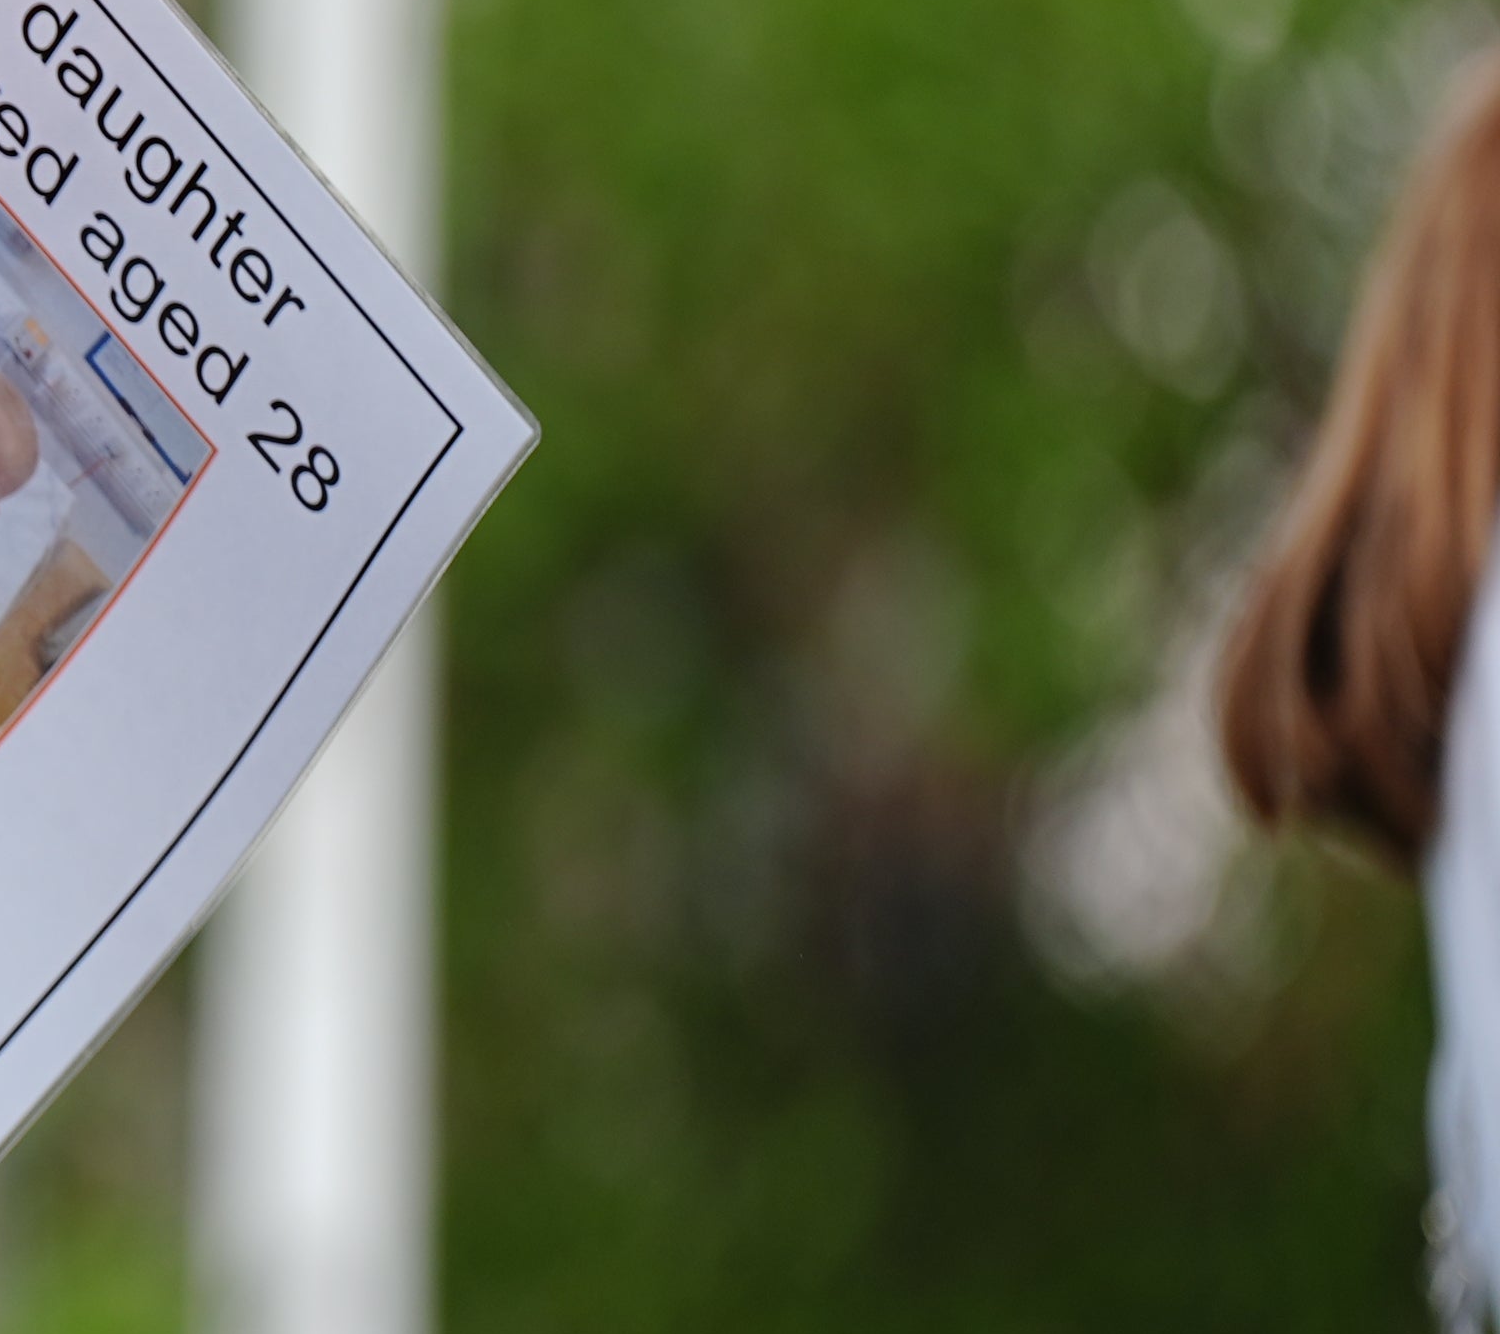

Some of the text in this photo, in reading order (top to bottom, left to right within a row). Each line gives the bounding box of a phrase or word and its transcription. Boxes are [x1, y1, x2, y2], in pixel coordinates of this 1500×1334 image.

[21, 1, 306, 329] daughter
[78, 209, 252, 406] aged
[245, 399, 343, 514] 28
